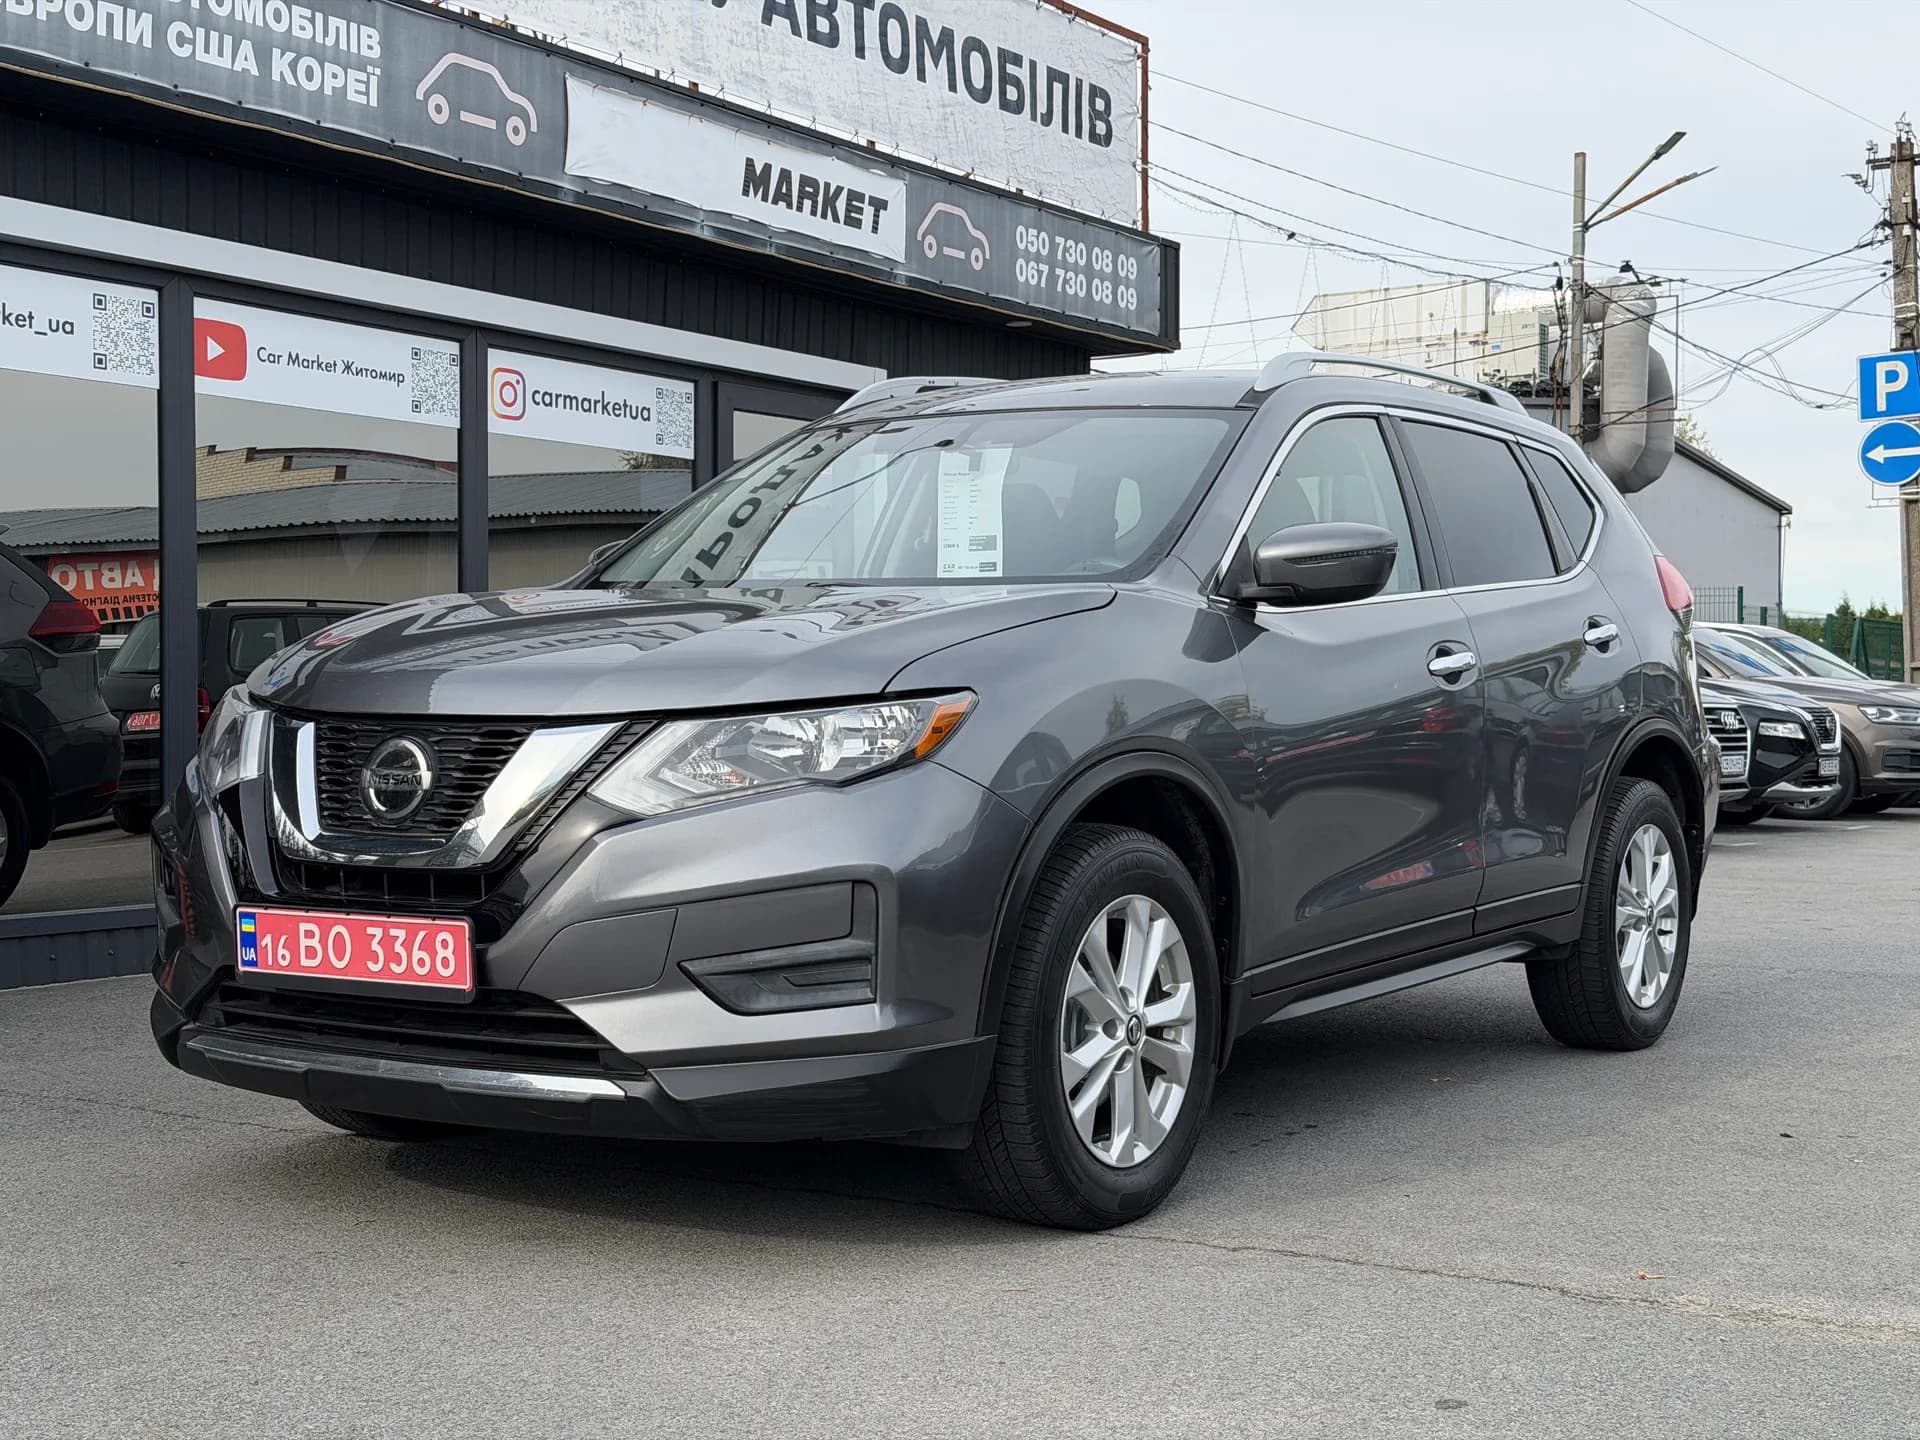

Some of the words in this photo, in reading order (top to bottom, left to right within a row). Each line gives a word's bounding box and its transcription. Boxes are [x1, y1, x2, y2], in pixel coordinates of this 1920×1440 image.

[167, 0, 381, 59] ОМОБІЛІВ
[166, 21, 260, 77] США
[272, 47, 382, 107] КОРЕЇ
[741, 157, 889, 234] MARKET
[1016, 225, 1049, 256] 050
[1055, 236, 1087, 266] 730
[1092, 247, 1112, 273] 08
[1117, 254, 1137, 280] 09
[1016, 258, 1049, 288] 067
[1055, 268, 1087, 298] 730
[1092, 278, 1112, 304] 08
[1117, 285, 1137, 311] 09
[0, 302, 74, 336] ket_ua
[256, 346, 283, 365] Car
[287, 351, 338, 373] Market
[341, 359, 405, 387] Житомир
[532, 389, 652, 422] carmarketua
[368, 771, 422, 786] NISSAN
[242, 946, 257, 962] UA
[260, 933, 291, 967] 16
[366, 926, 456, 978] 3368
